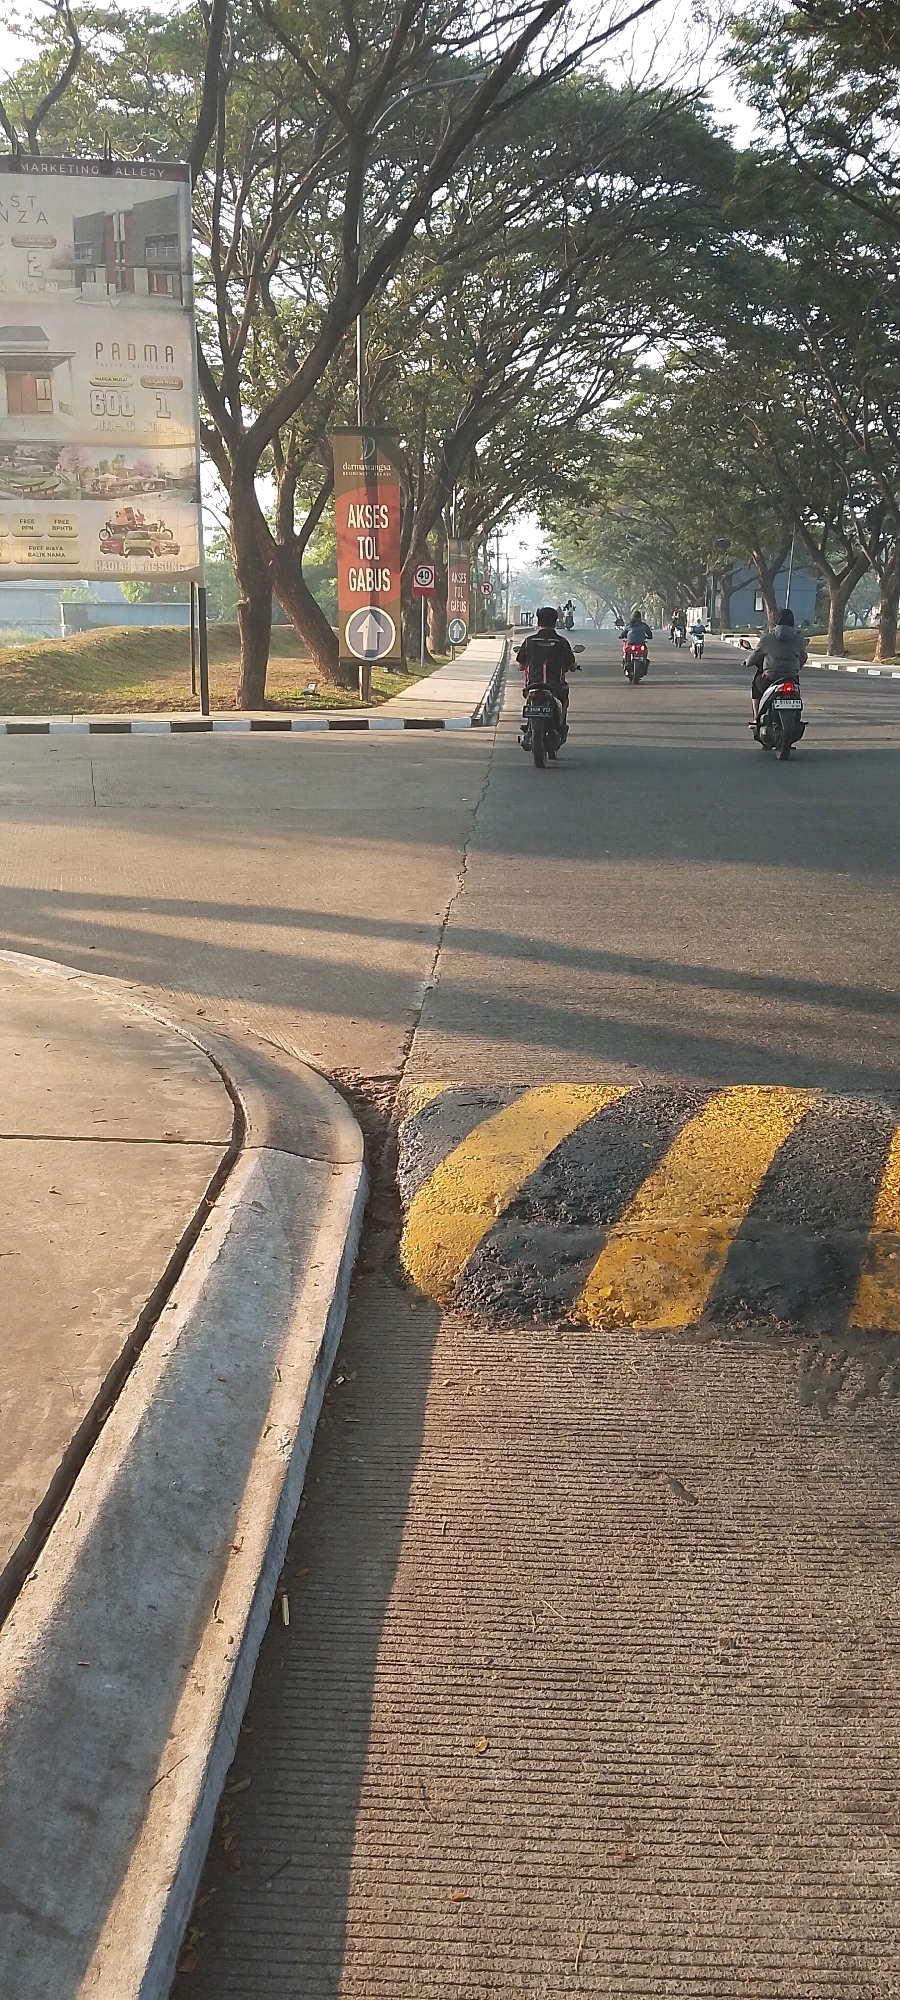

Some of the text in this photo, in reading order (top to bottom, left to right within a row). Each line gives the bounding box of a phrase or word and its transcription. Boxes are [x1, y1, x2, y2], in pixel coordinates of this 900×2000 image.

[21, 163, 165, 178] MARKETING ALLERY
[0, 195, 37, 209] ST
[27, 250, 43, 277] 2
[95, 342, 174, 363] PADMA
[90, 389, 136, 418] 600
[156, 392, 171, 419] 1
[347, 504, 389, 530] AKSES
[357, 536, 380, 560] TOL
[95, 560, 184, 572] HADIAH LANGSUNG
[418, 570, 430, 580] 40
[348, 567, 391, 593] GABUS
[451, 572, 467, 584] AKSES
[454, 586, 464, 598] TOL
